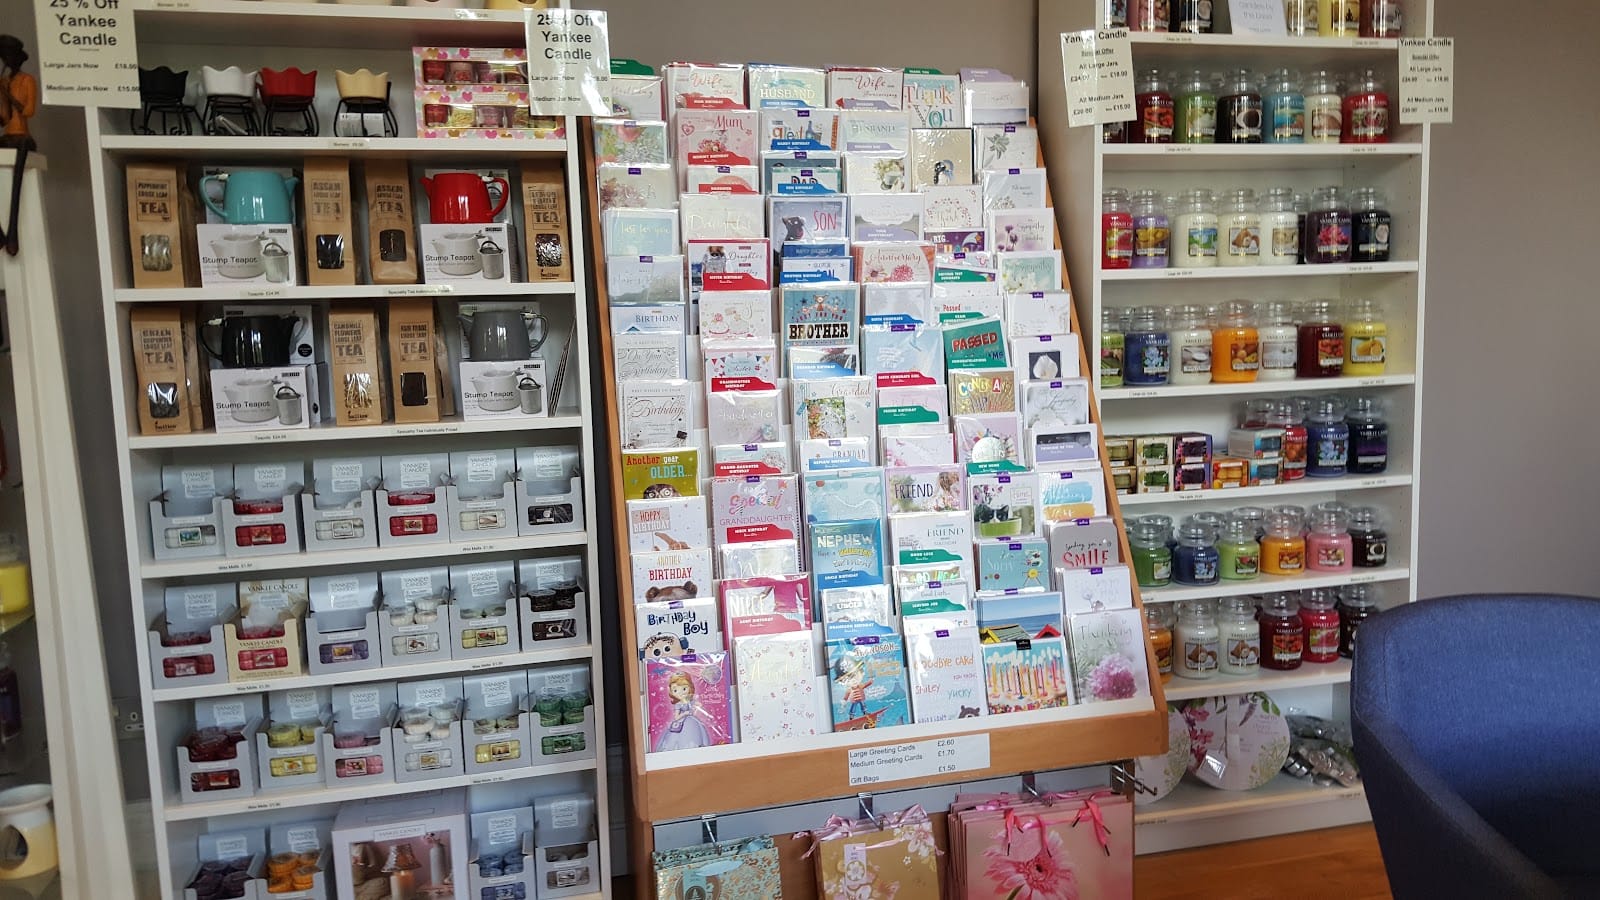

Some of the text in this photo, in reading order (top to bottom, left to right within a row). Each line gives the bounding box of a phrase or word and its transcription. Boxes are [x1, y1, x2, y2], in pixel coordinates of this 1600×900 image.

[56, 14, 117, 28] Yankee
[59, 32, 117, 46] Candle
[542, 31, 592, 43] Yankee
[1098, 30, 1128, 40] Candle
[1400, 38, 1452, 47] Yankee Candle
[544, 47, 592, 60] Candle
[43, 62, 65, 70] Large
[690, 73, 722, 88] Wife
[855, 75, 886, 91] Wife
[46, 84, 75, 92] Medium
[760, 88, 816, 99] HUSBAND
[713, 115, 745, 135] Mum
[311, 182, 341, 191] ASSAM
[139, 202, 169, 214] TEA
[314, 202, 341, 215] TEA
[378, 201, 404, 213] TEA
[533, 211, 560, 223] TEA
[813, 210, 837, 232] SON
[202, 256, 258, 266] Stump Teapot
[425, 254, 475, 263] Stump Teapot
[635, 313, 680, 324] BIRTHDAY
[788, 323, 849, 341] BROTHER
[401, 341, 427, 353] TEA
[952, 332, 999, 353] PASSED
[336, 344, 363, 357] TEA
[144, 352, 174, 364] TEA
[464, 391, 514, 400] Stump Teapot
[216, 400, 270, 410] Stump Teapot
[632, 399, 685, 421] Birthday
[626, 455, 679, 466] Another year
[894, 482, 934, 499] FRIEND
[639, 510, 661, 523] HOPPY
[634, 520, 671, 533] BIRTHDAY
[927, 527, 965, 538] FRIEND
[817, 533, 873, 548] NEPHEW
[648, 567, 692, 581] BIRTHDAY
[849, 739, 955, 760] Large Greeting Cards £2.60
[850, 749, 955, 769] Medium Greeting Cards £1.70
[938, 764, 956, 773] £1.50
[850, 774, 880, 784] Gift Bags
